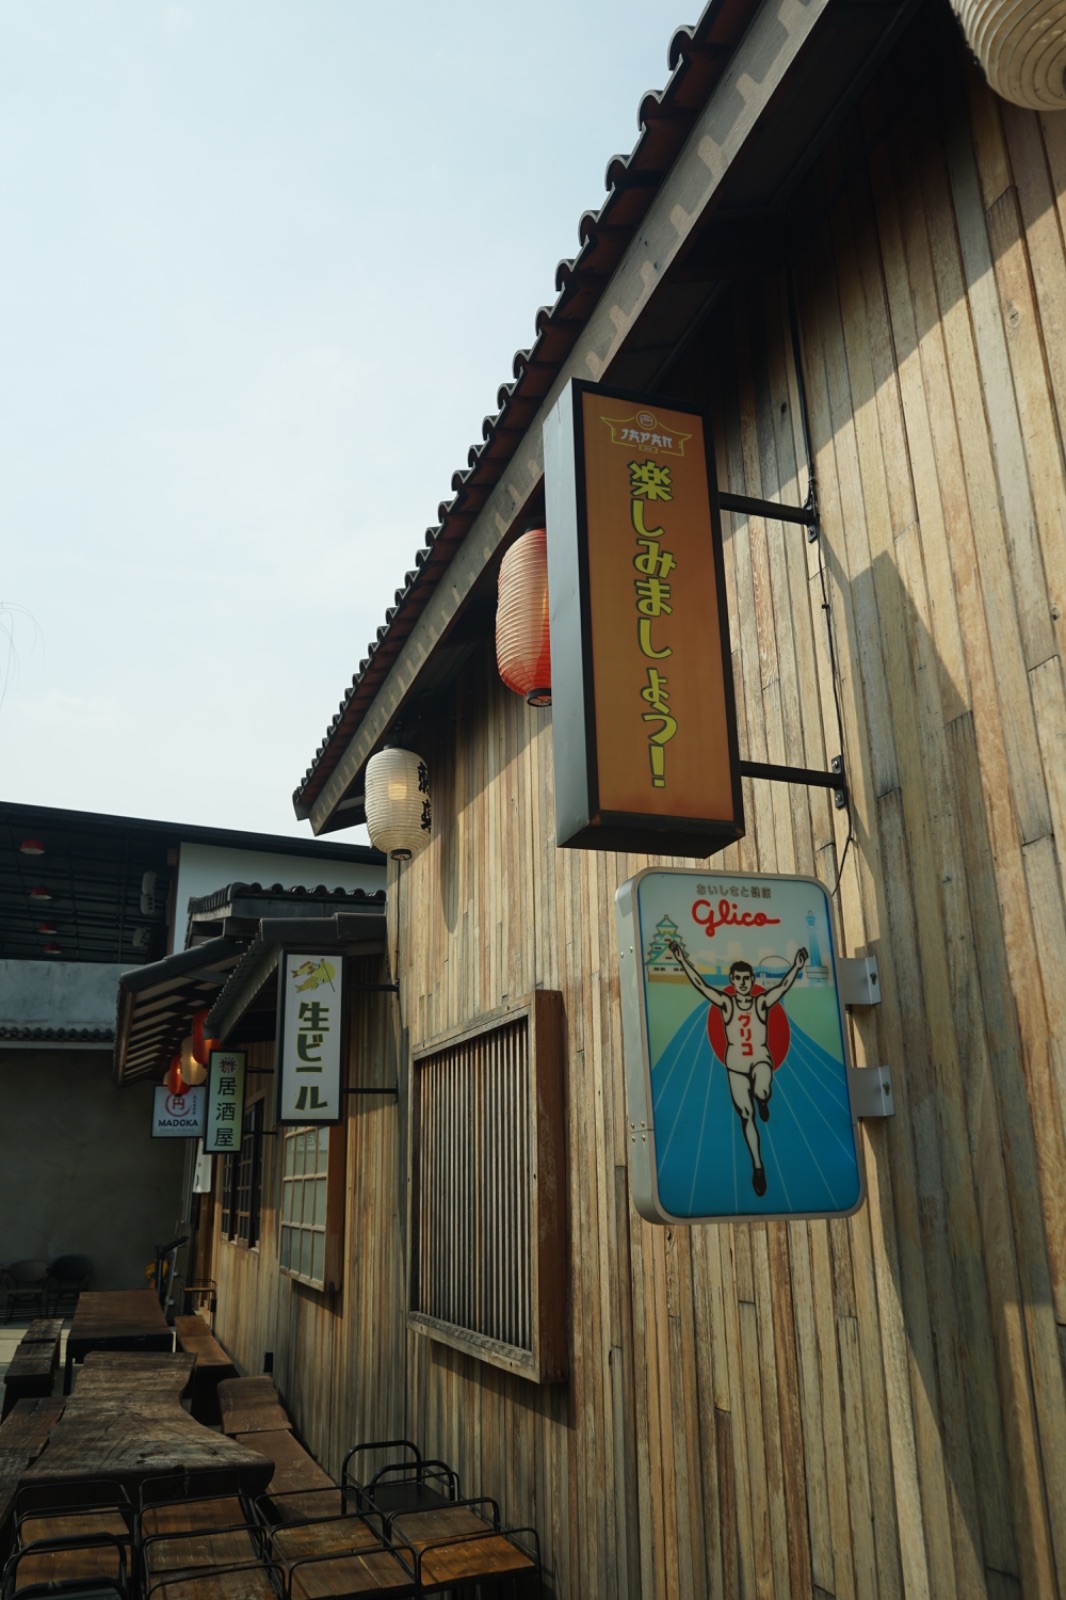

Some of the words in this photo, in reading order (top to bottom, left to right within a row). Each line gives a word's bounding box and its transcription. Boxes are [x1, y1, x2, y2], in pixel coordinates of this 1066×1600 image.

[620, 428, 673, 448] JAPAN
[691, 898, 781, 938] Glico
[737, 1012, 753, 1056] グリコ
[294, 1001, 330, 1111] 生ビール
[158, 1119, 198, 1127] MADOKA
[214, 1077, 237, 1147] 居酒屋
